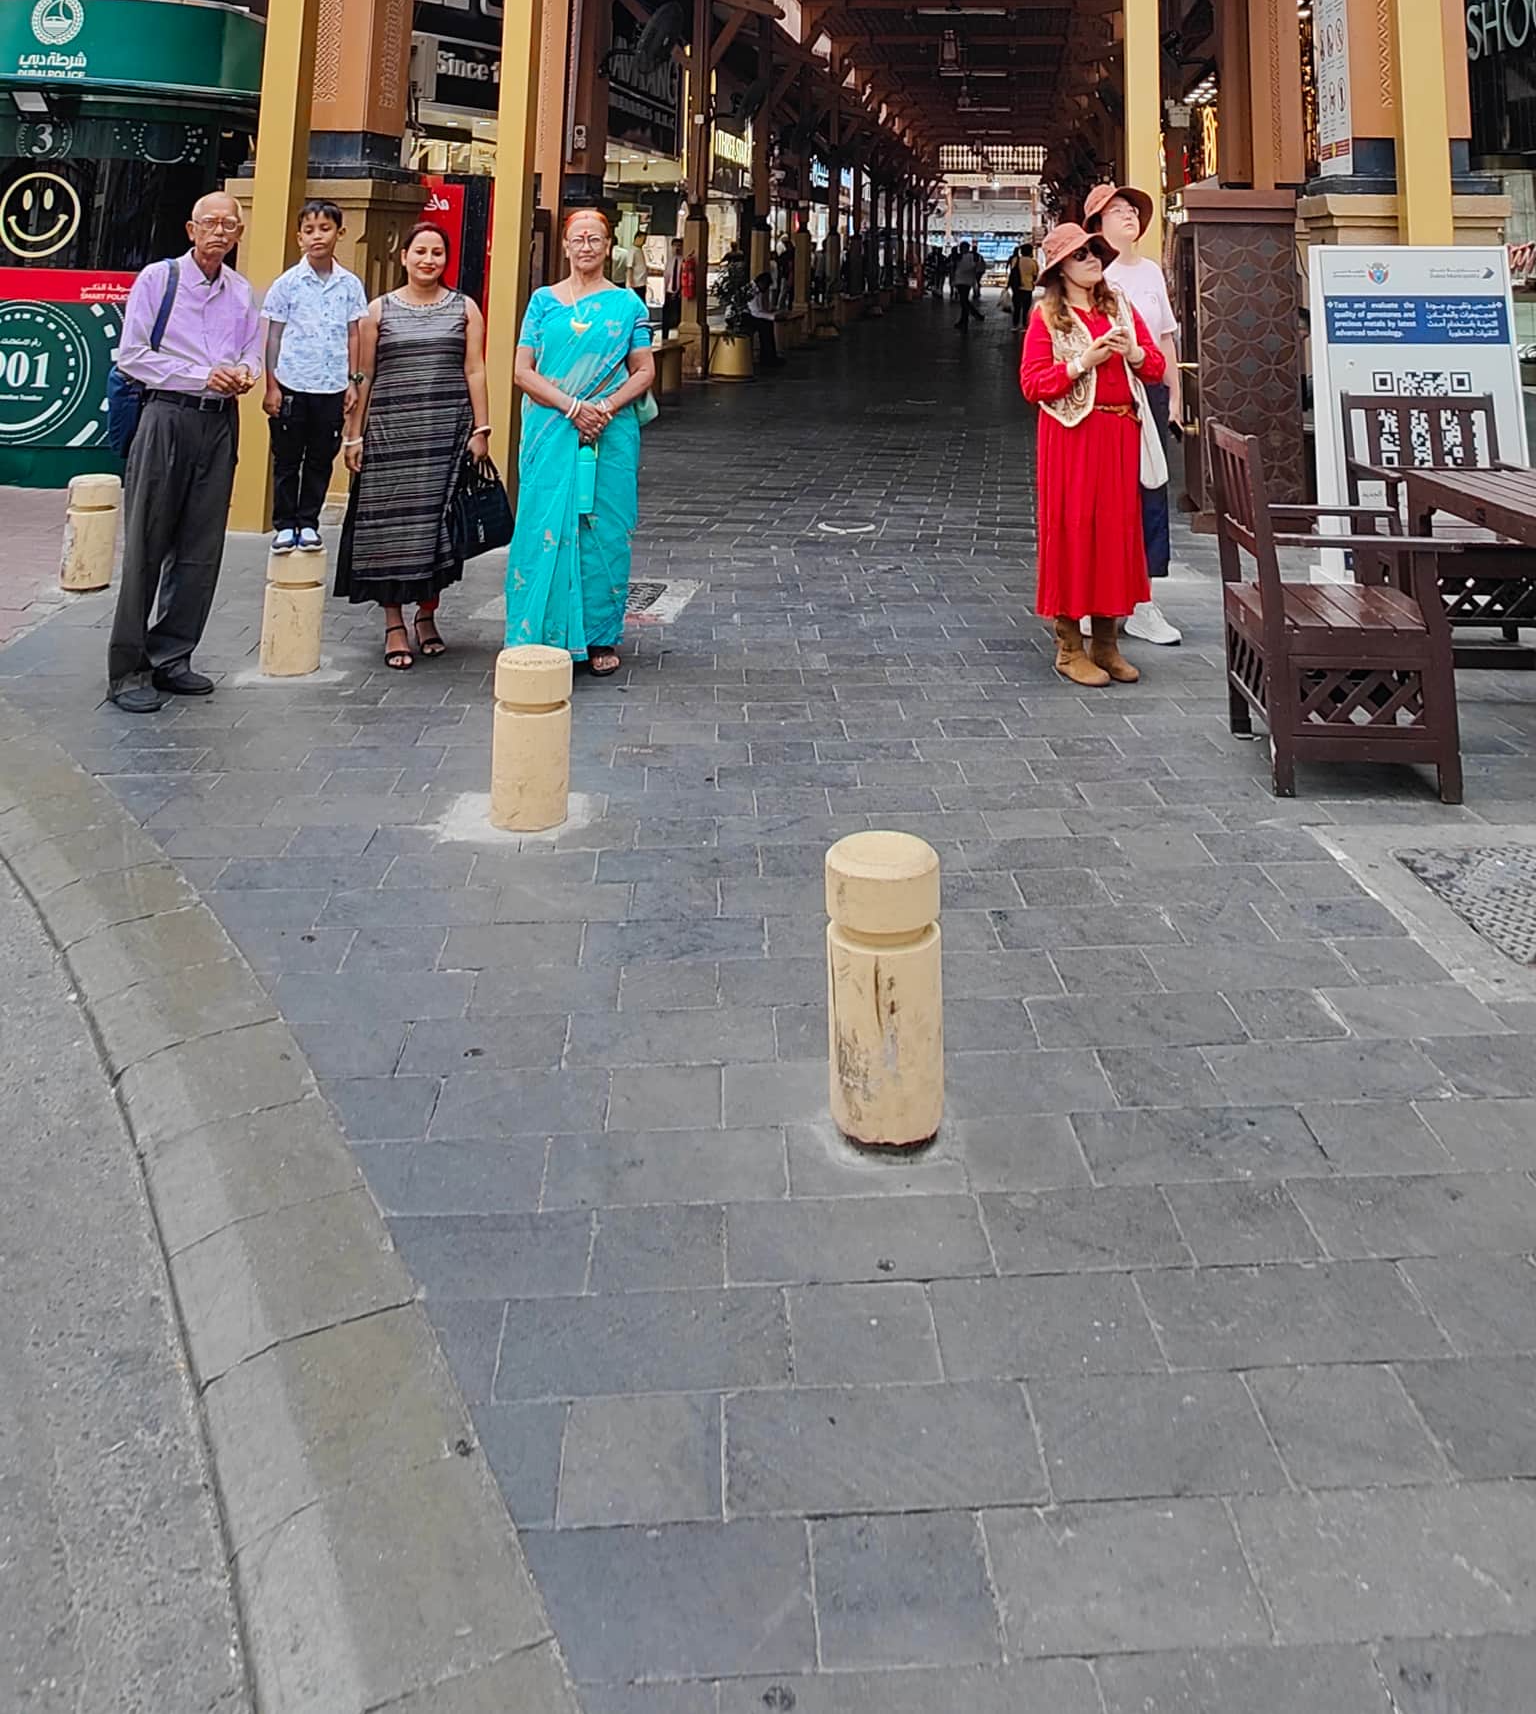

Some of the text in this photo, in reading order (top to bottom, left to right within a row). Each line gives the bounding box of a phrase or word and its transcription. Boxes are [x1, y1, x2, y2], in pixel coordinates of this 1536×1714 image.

[18, 51, 87, 70] شرطة دبي
[436, 50, 489, 81] Since
[31, 123, 54, 154] 3
[106, 293, 129, 301] POLIC
